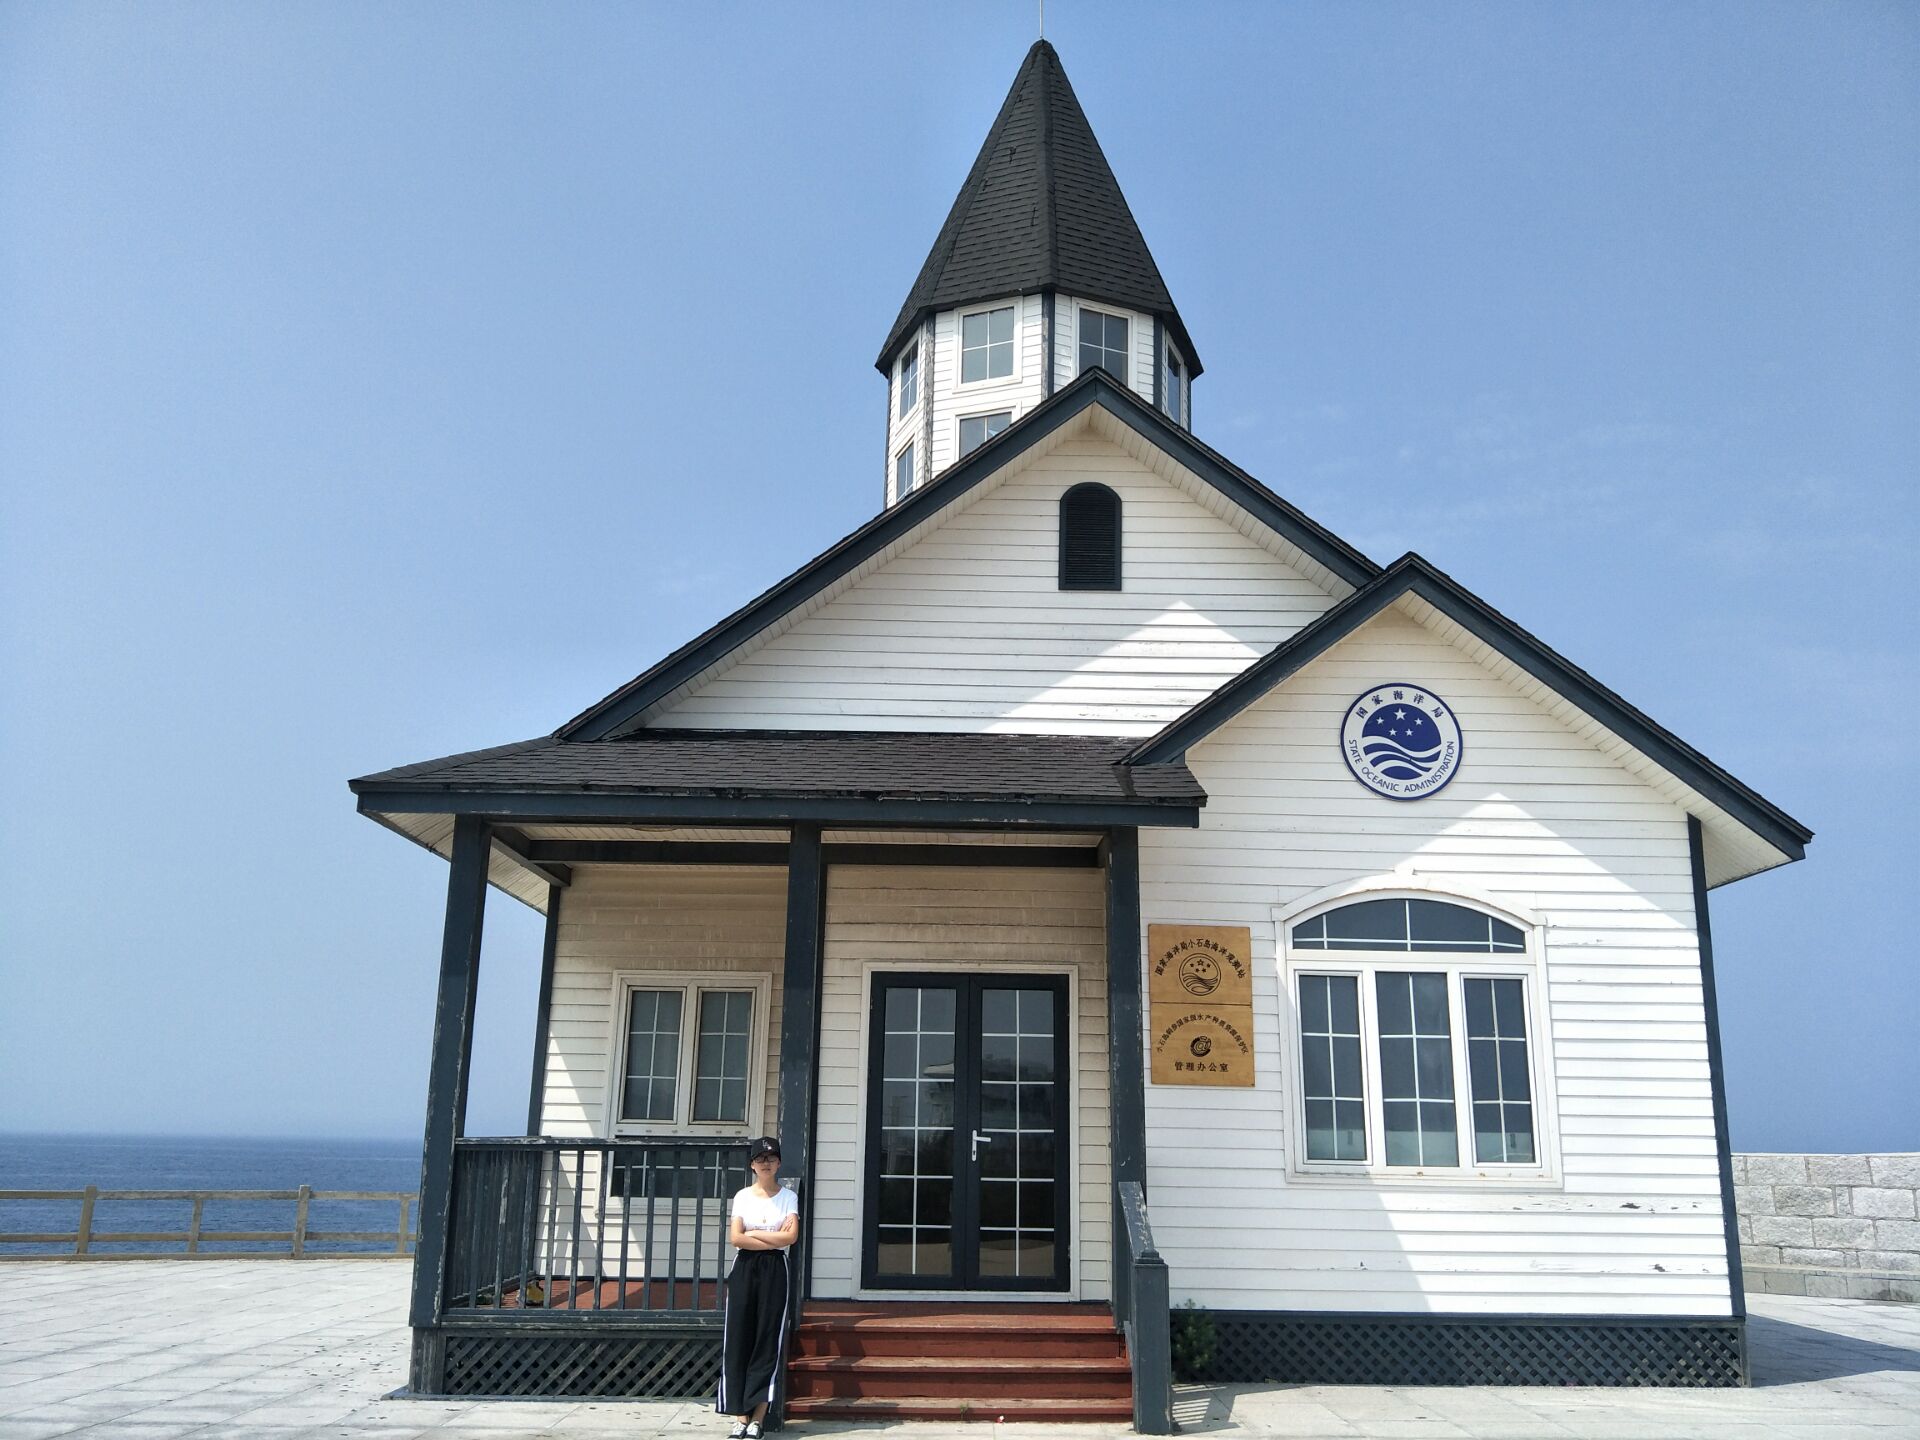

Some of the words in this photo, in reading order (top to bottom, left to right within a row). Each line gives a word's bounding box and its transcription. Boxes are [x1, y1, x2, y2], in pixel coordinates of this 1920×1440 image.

[1355, 690, 1444, 719] 国家海洋局
[1349, 739, 1363, 764] STATE
[1361, 766, 1399, 792] OCEANIC
[1404, 741, 1454, 793] ADMINISTRATION
[1175, 1061, 1229, 1072] 管理办公室
